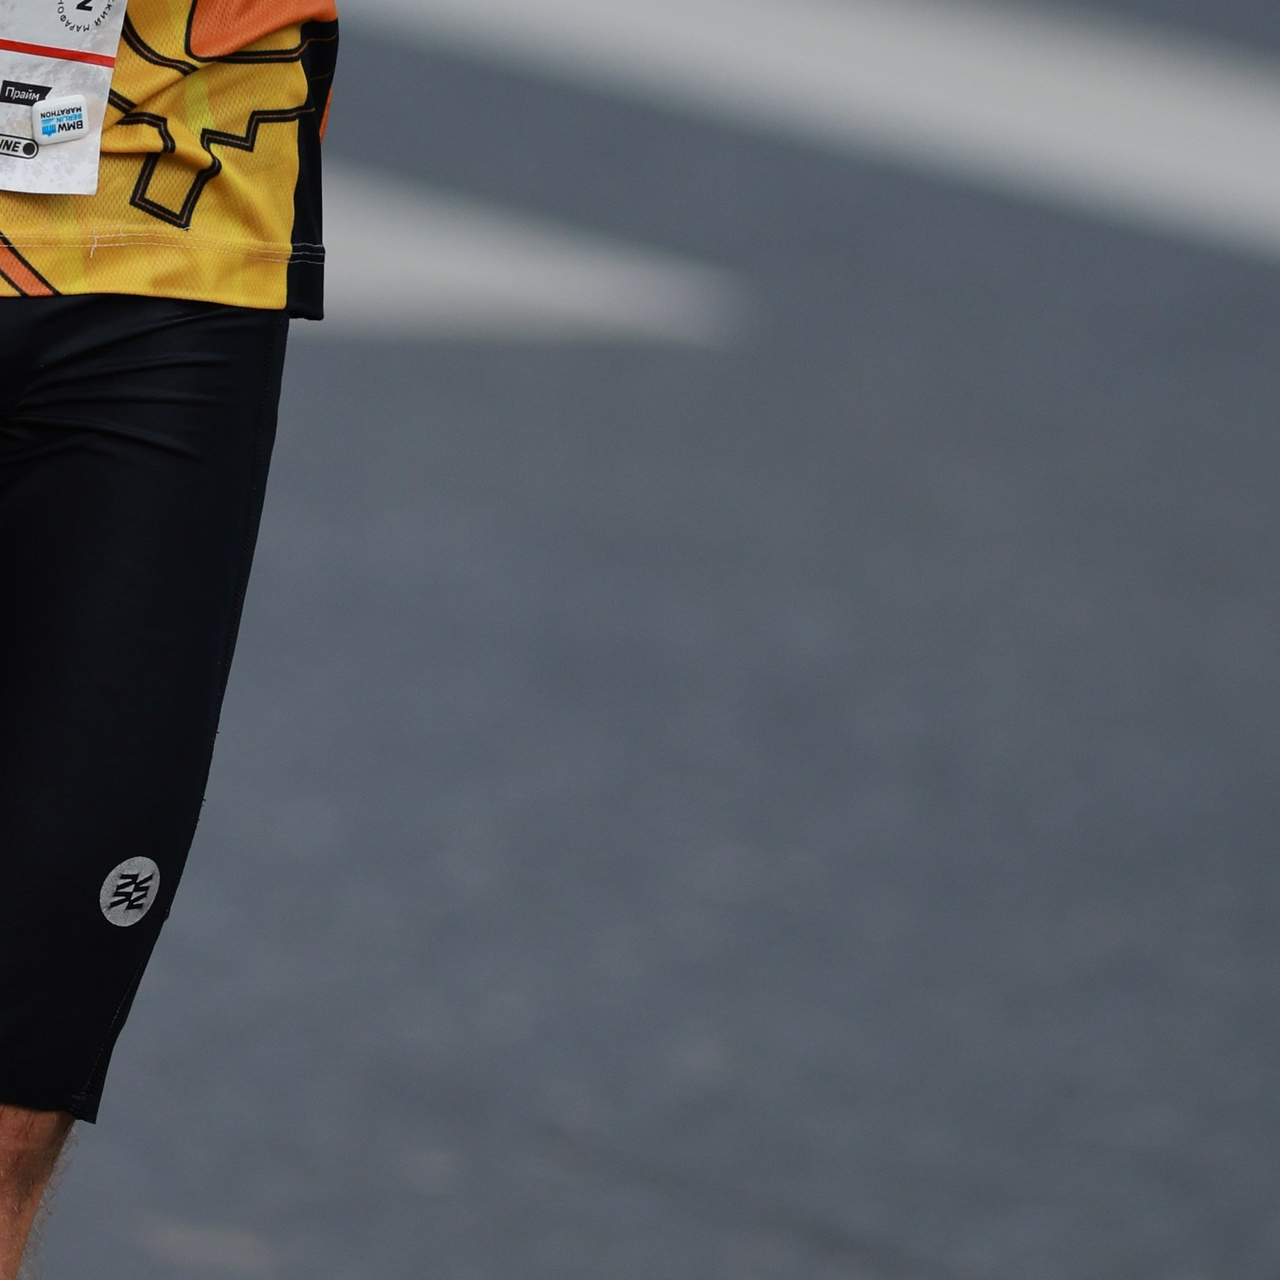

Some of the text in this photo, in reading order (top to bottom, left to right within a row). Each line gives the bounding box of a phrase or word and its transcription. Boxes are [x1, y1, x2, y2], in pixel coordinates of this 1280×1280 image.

[5, 86, 40, 101] Прайм
[40, 106, 82, 119] MARATHON
[56, 113, 82, 123] BERLIN
[57, 120, 83, 133] BMW
